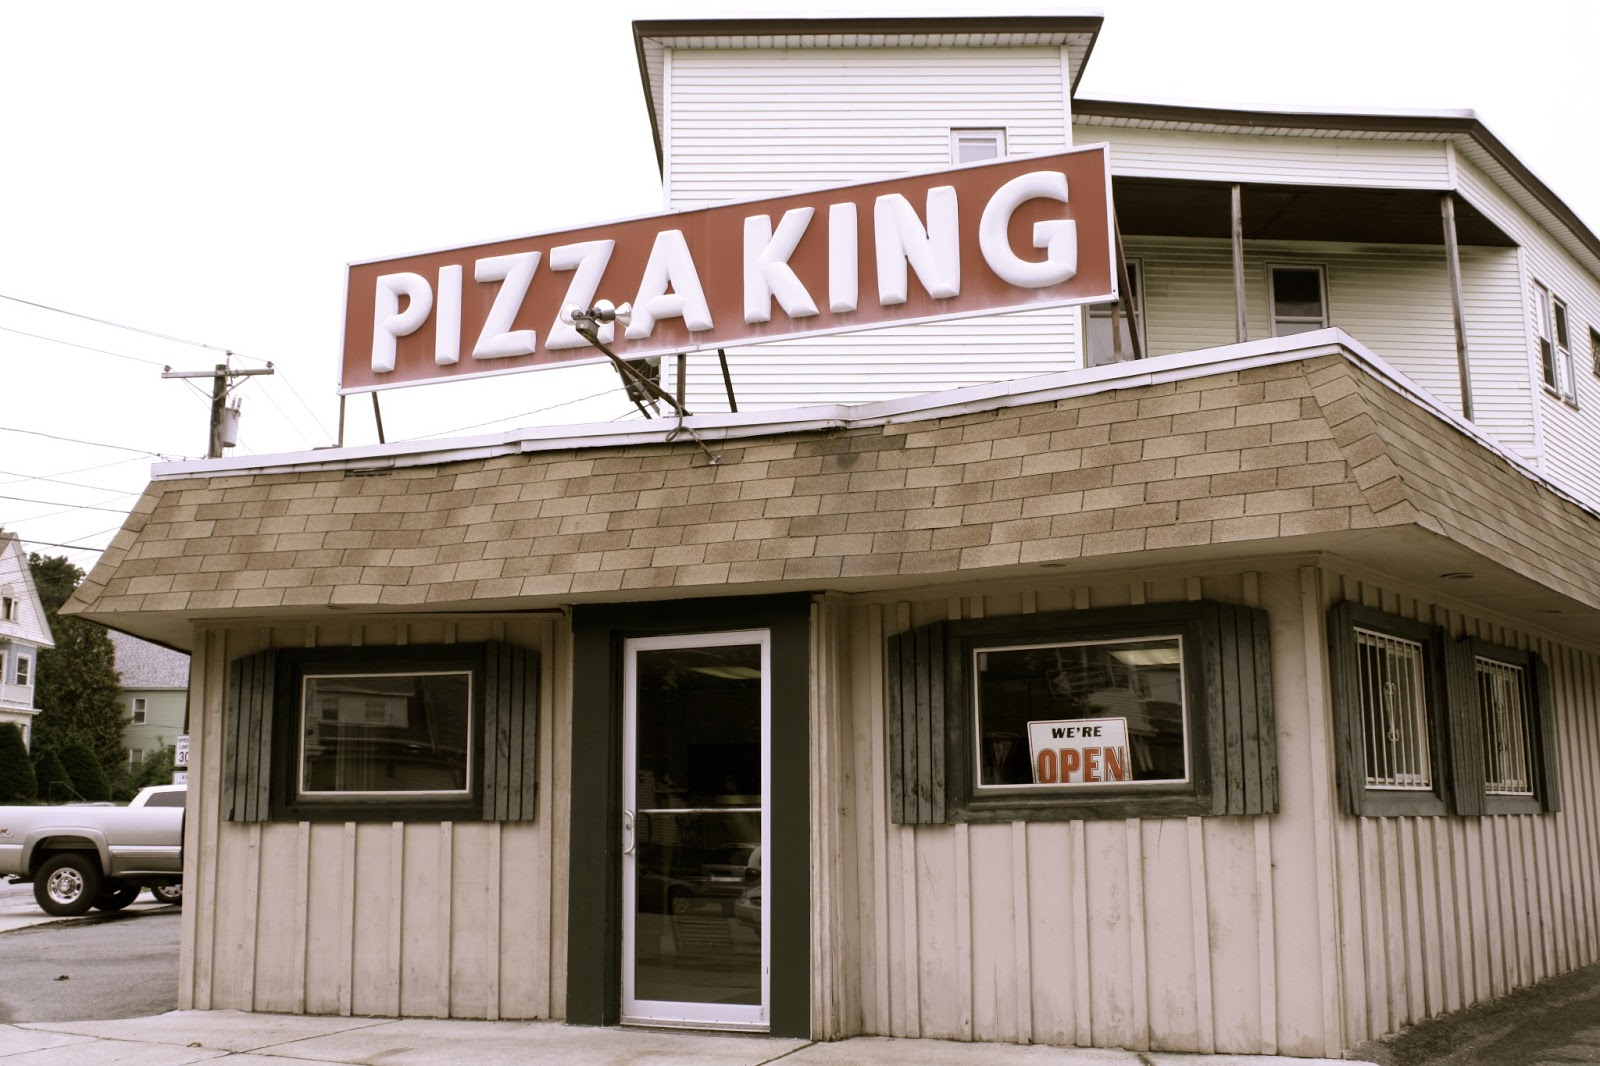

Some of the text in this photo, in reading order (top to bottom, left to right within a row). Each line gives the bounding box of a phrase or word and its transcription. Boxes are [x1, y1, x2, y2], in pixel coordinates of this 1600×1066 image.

[372, 170, 1078, 373] PIZZA KING
[1052, 726, 1103, 739] WE'RE
[1037, 746, 1126, 783] OPEN
